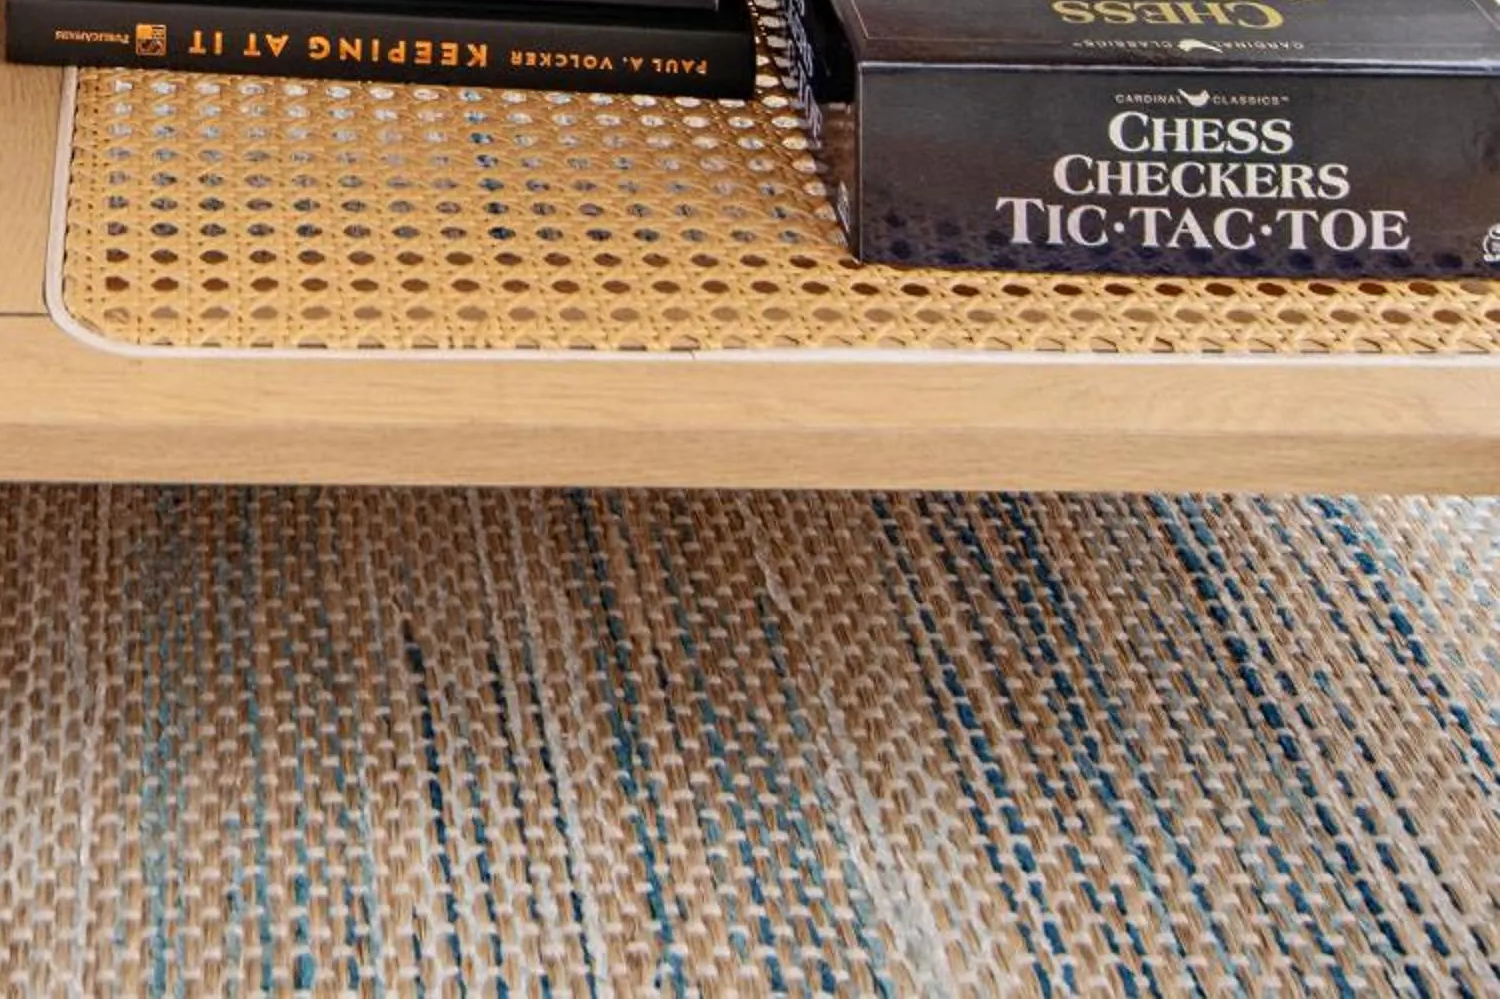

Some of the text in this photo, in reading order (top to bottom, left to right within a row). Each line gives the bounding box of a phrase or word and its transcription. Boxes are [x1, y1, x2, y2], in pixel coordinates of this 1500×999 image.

[1051, 0, 1285, 30] CHESS
[188, 30, 708, 76] PAUL A. VOLCKER KEEPING AT IT
[1115, 94, 1182, 106] CARDINAL
[1108, 111, 1294, 155] CHESS
[1053, 154, 1352, 200] CHECKERS
